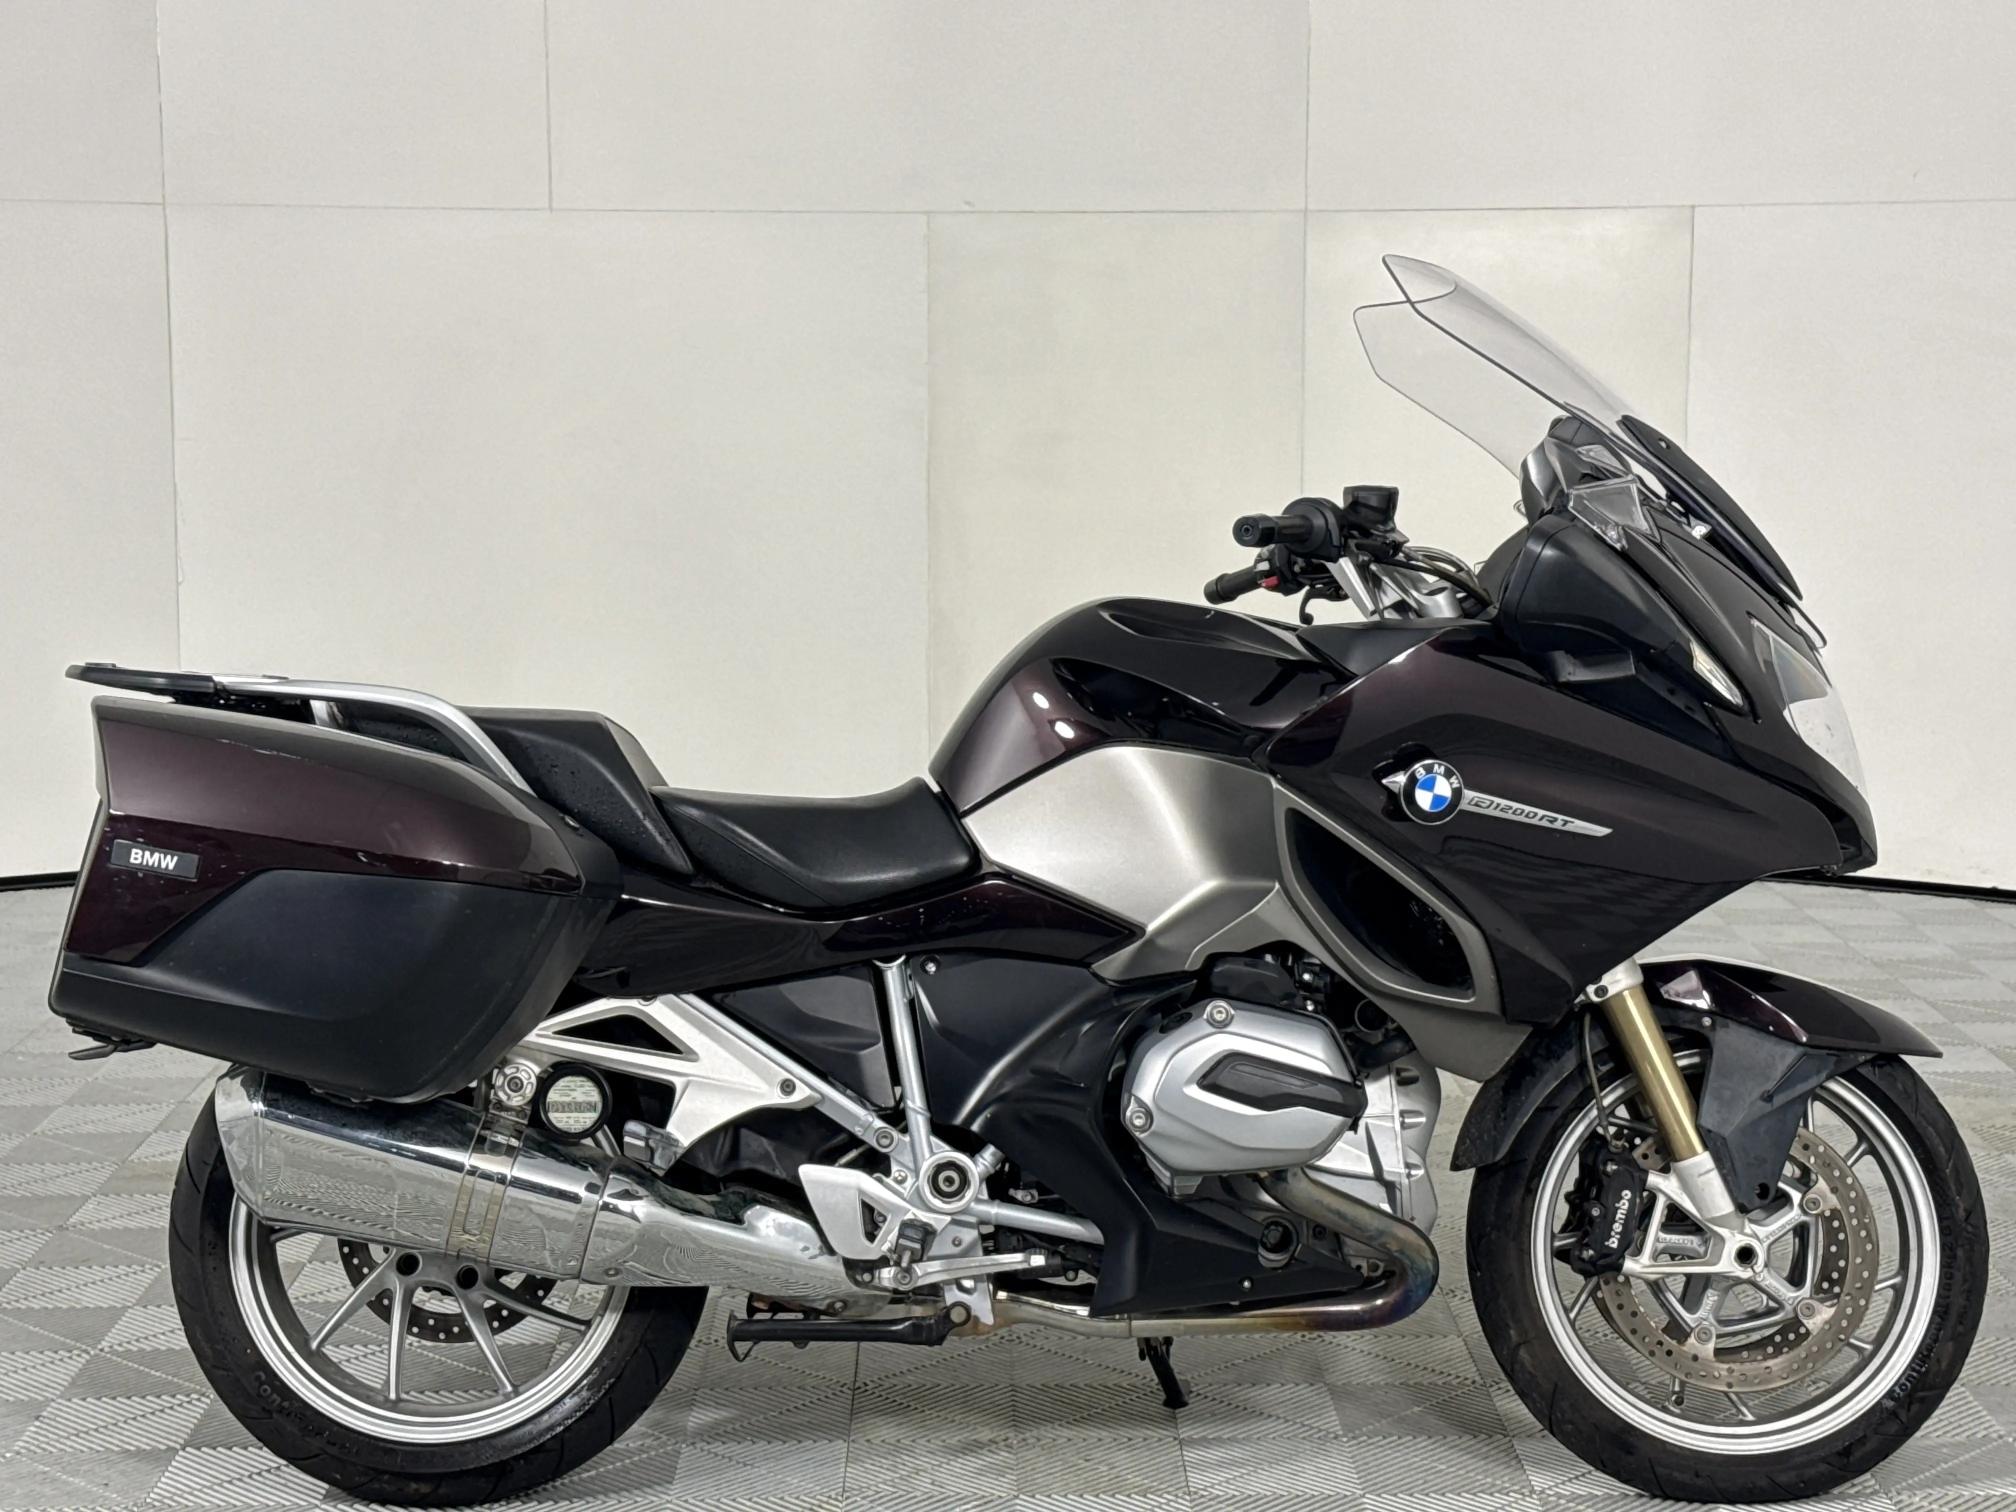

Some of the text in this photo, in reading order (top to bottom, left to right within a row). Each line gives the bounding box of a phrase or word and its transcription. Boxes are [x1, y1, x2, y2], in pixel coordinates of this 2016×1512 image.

[1415, 763, 1461, 789] BMW
[129, 848, 178, 871] BMW
[1604, 1189, 1632, 1249] brembo
